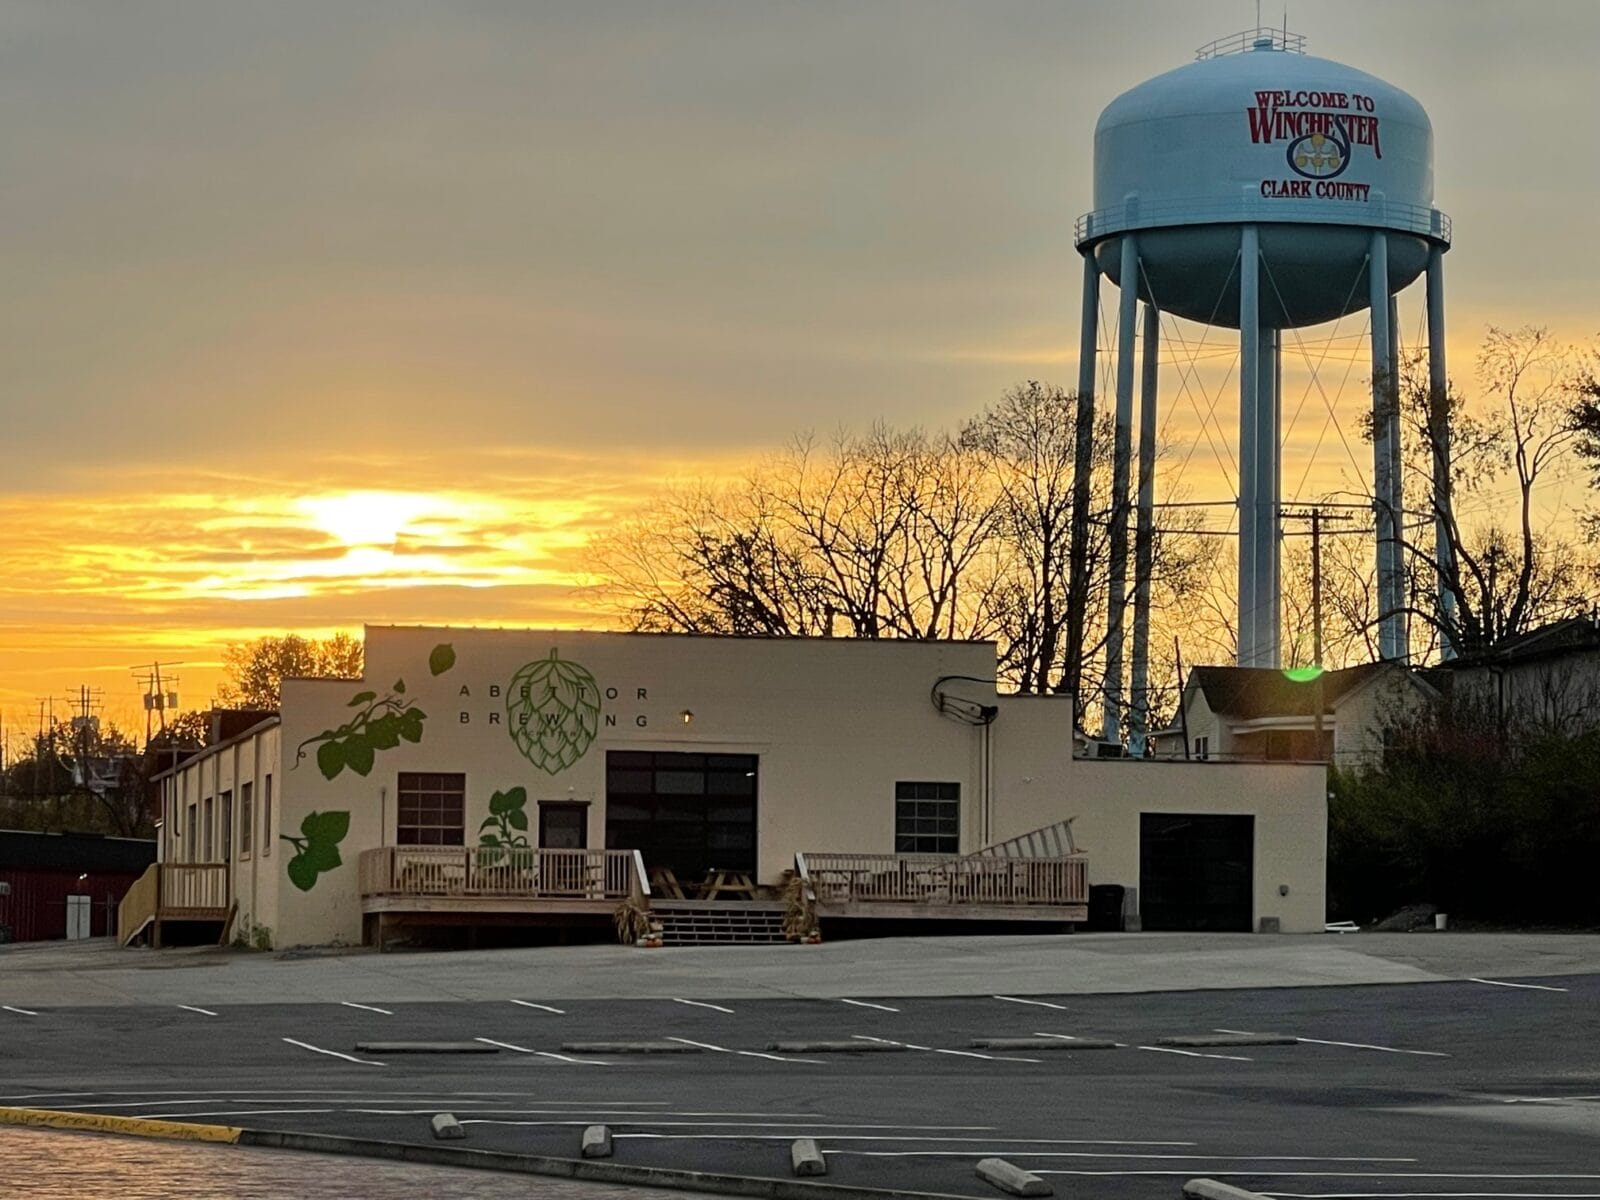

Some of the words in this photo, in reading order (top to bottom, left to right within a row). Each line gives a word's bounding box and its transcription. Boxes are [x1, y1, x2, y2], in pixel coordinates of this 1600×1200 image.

[1254, 90, 1349, 109] WELCOME
[1352, 94, 1375, 113] TO
[1247, 107, 1382, 160] WINCHESTER
[1260, 180, 1312, 198] CLARK
[1315, 180, 1371, 202] COUNTY
[458, 685, 648, 701] ABETTOR
[458, 711, 648, 728] BREWING
